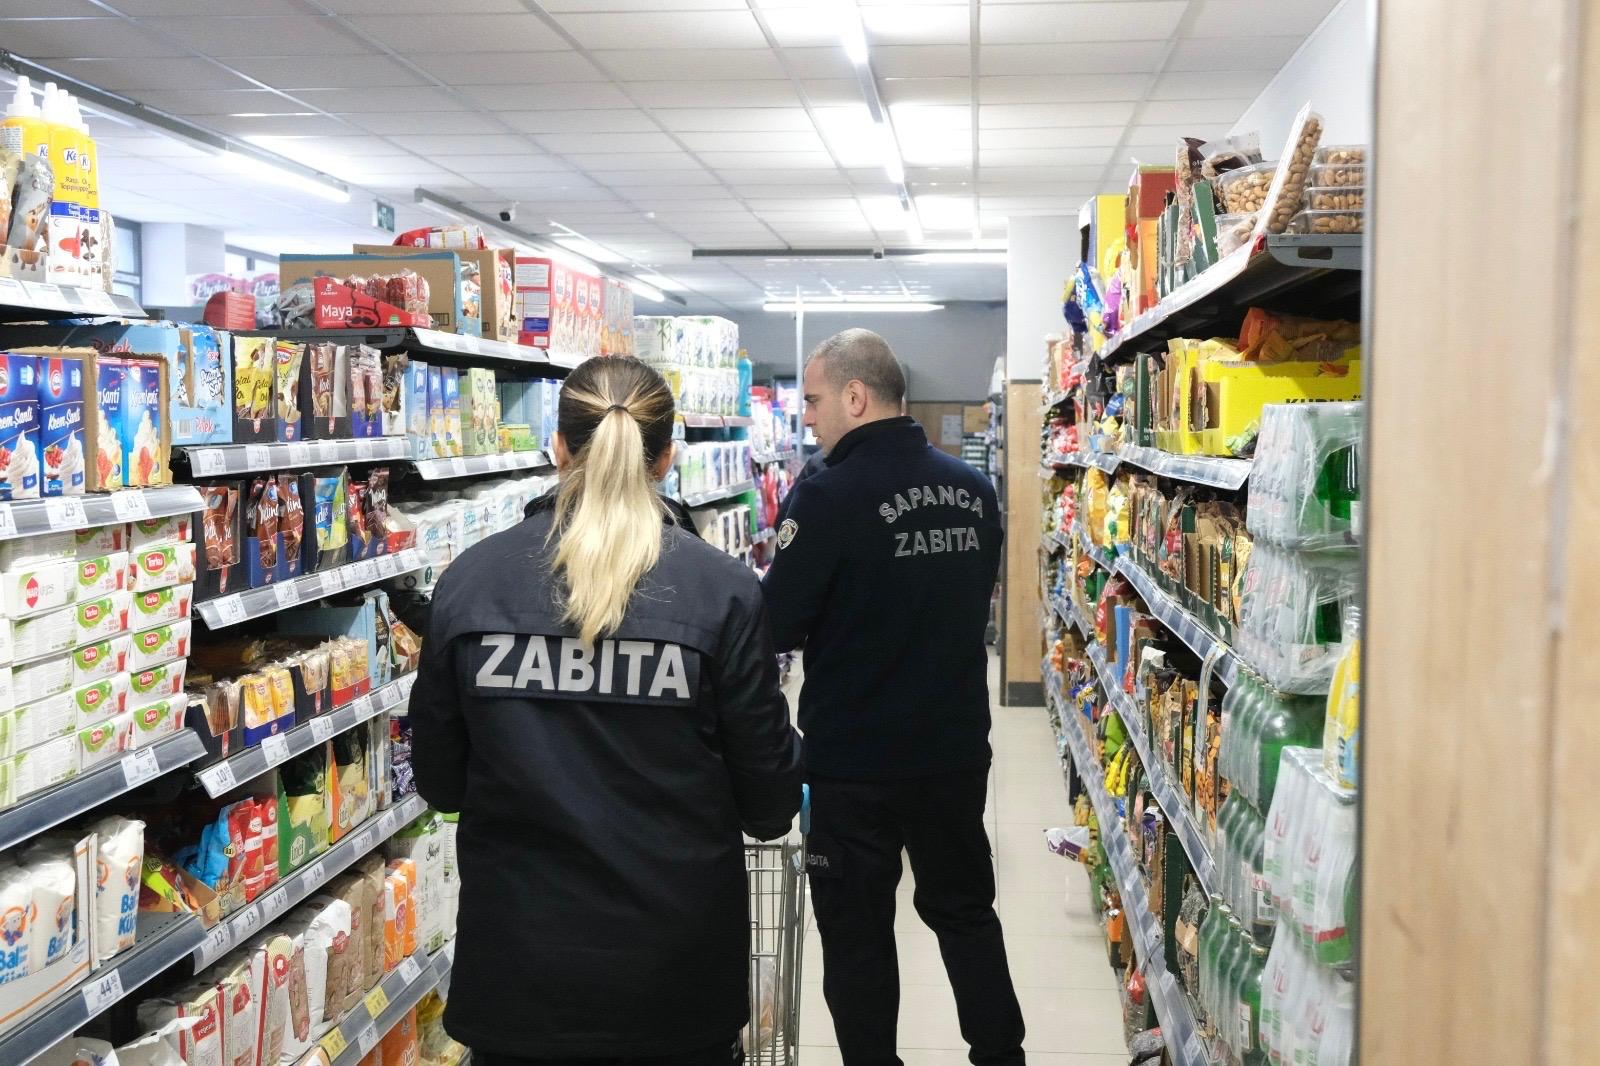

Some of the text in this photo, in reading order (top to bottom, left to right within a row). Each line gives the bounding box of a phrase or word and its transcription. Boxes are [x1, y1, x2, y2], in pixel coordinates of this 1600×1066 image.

[321, 304, 353, 320] Maya
[879, 485, 983, 524] SAPANCA
[894, 526, 981, 557] ZABITA
[475, 634, 690, 698] ZABITA
[210, 929, 225, 947] 12
[101, 980, 112, 997] 44
